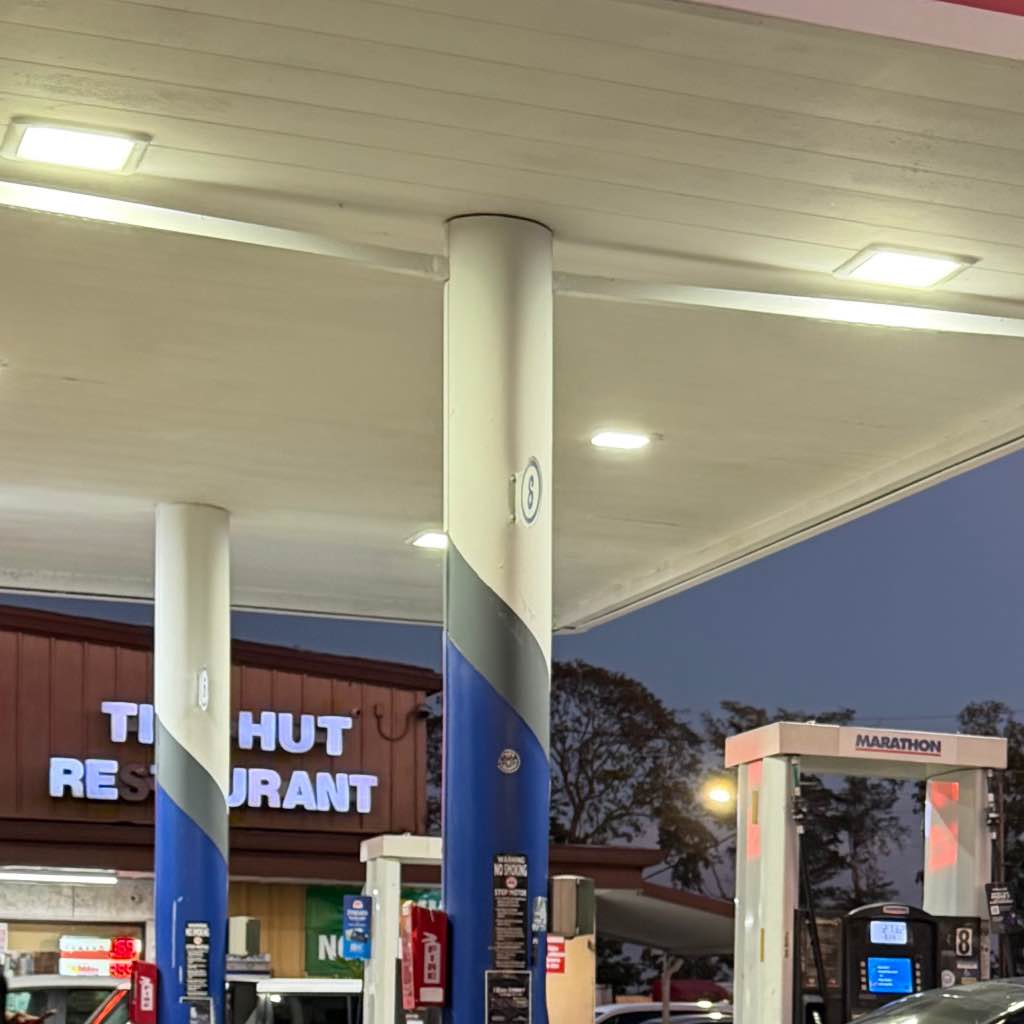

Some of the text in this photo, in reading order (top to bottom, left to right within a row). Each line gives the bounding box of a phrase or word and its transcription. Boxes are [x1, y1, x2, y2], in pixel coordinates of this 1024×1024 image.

[101, 701, 353, 757] TI HUT
[856, 734, 942, 753] MARATHON
[49, 757, 378, 814] RESURANT
[958, 929, 970, 954] 8
